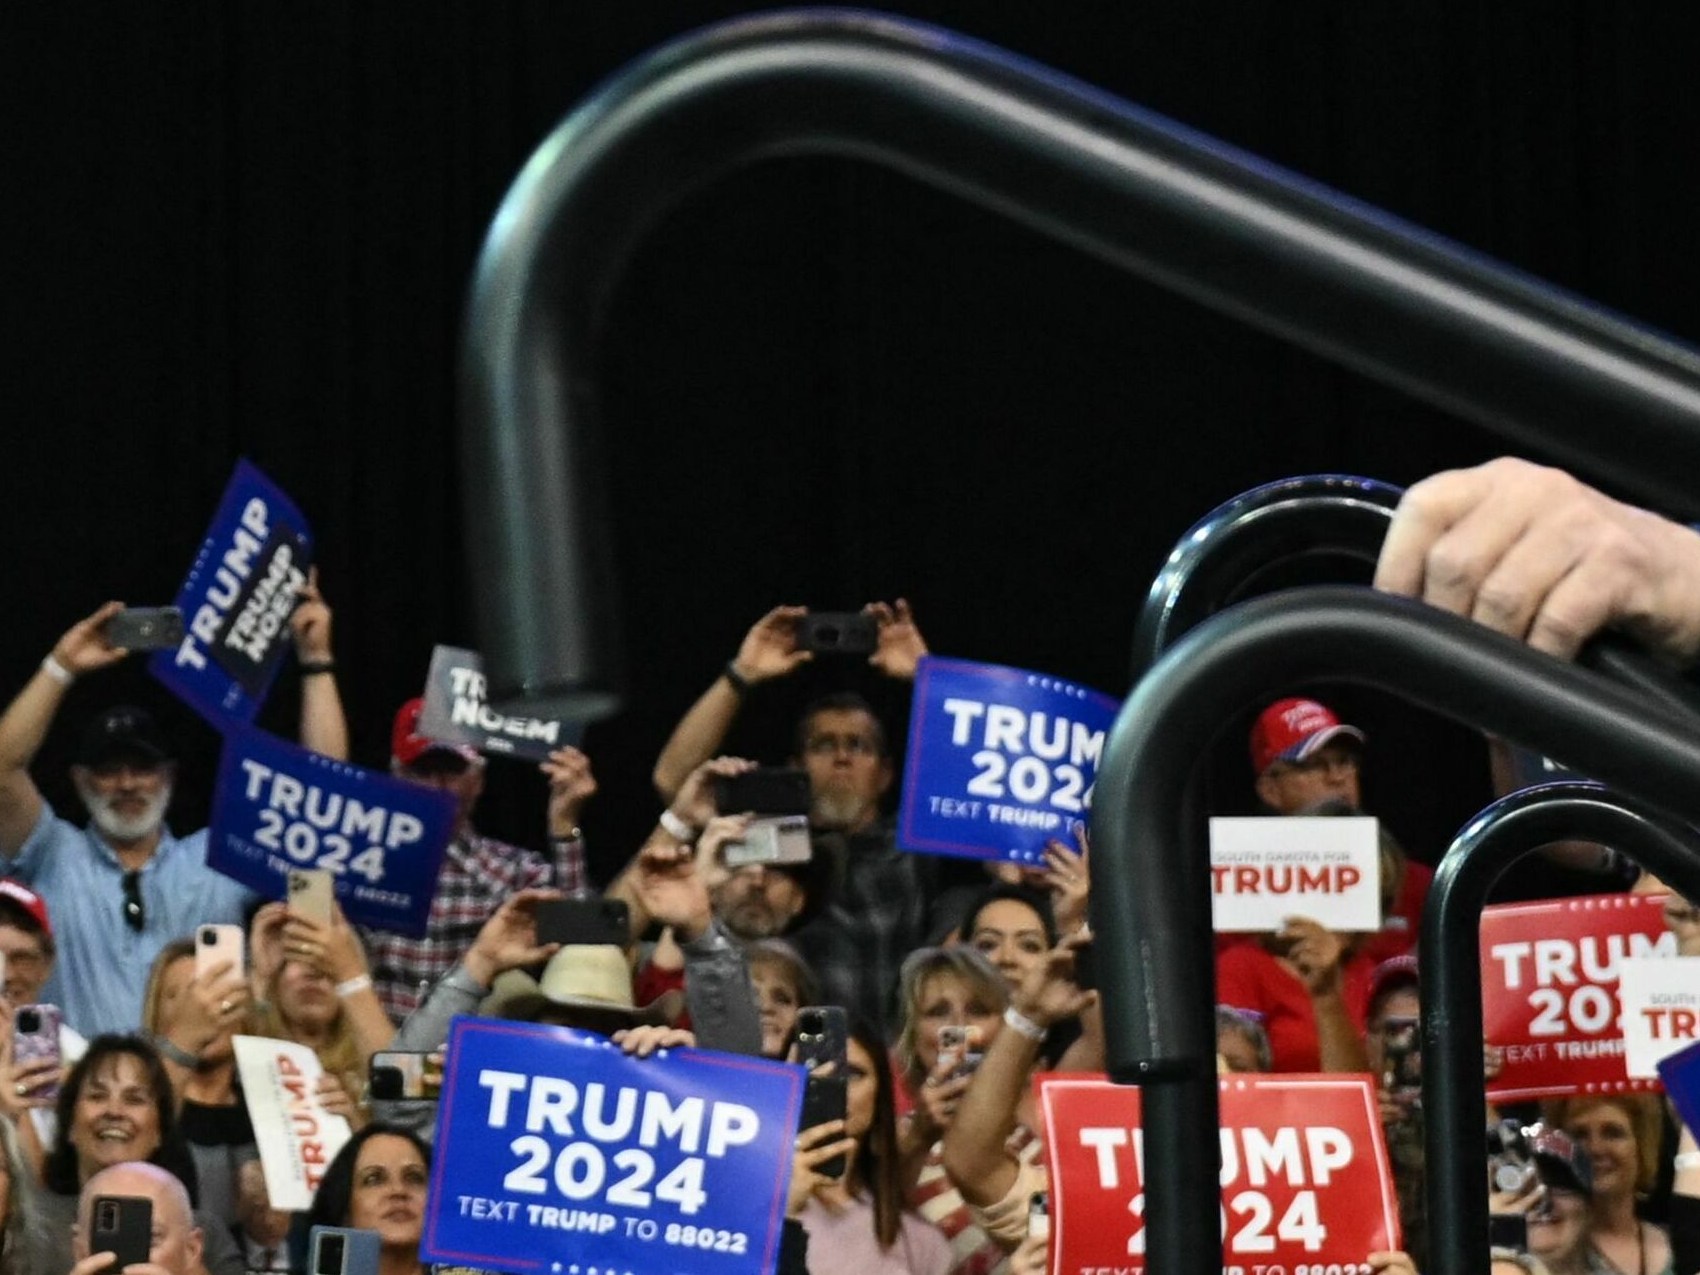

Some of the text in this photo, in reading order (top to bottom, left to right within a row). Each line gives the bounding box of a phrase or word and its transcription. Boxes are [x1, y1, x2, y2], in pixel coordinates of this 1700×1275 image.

[176, 497, 270, 671] TRUMP
[225, 544, 293, 648] TRUMP
[246, 566, 306, 663] NOEM
[450, 666, 487, 700] TR
[451, 696, 562, 746] NOEM
[943, 697, 1106, 773] TRUM
[241, 757, 425, 849] TRUMP
[928, 795, 983, 821] TEXT
[986, 803, 1062, 831] TRUMP
[253, 808, 385, 883] 2024
[1211, 864, 1362, 895] TRUMP
[1527, 985, 1624, 1037] 20
[478, 1068, 760, 1158] TRUMP
[503, 1134, 707, 1216] 2024
[1079, 1127, 1354, 1190] TMP
[457, 1195, 749, 1255] TEXT TRUMP TO 88022
[1127, 1190, 1327, 1255] 24
